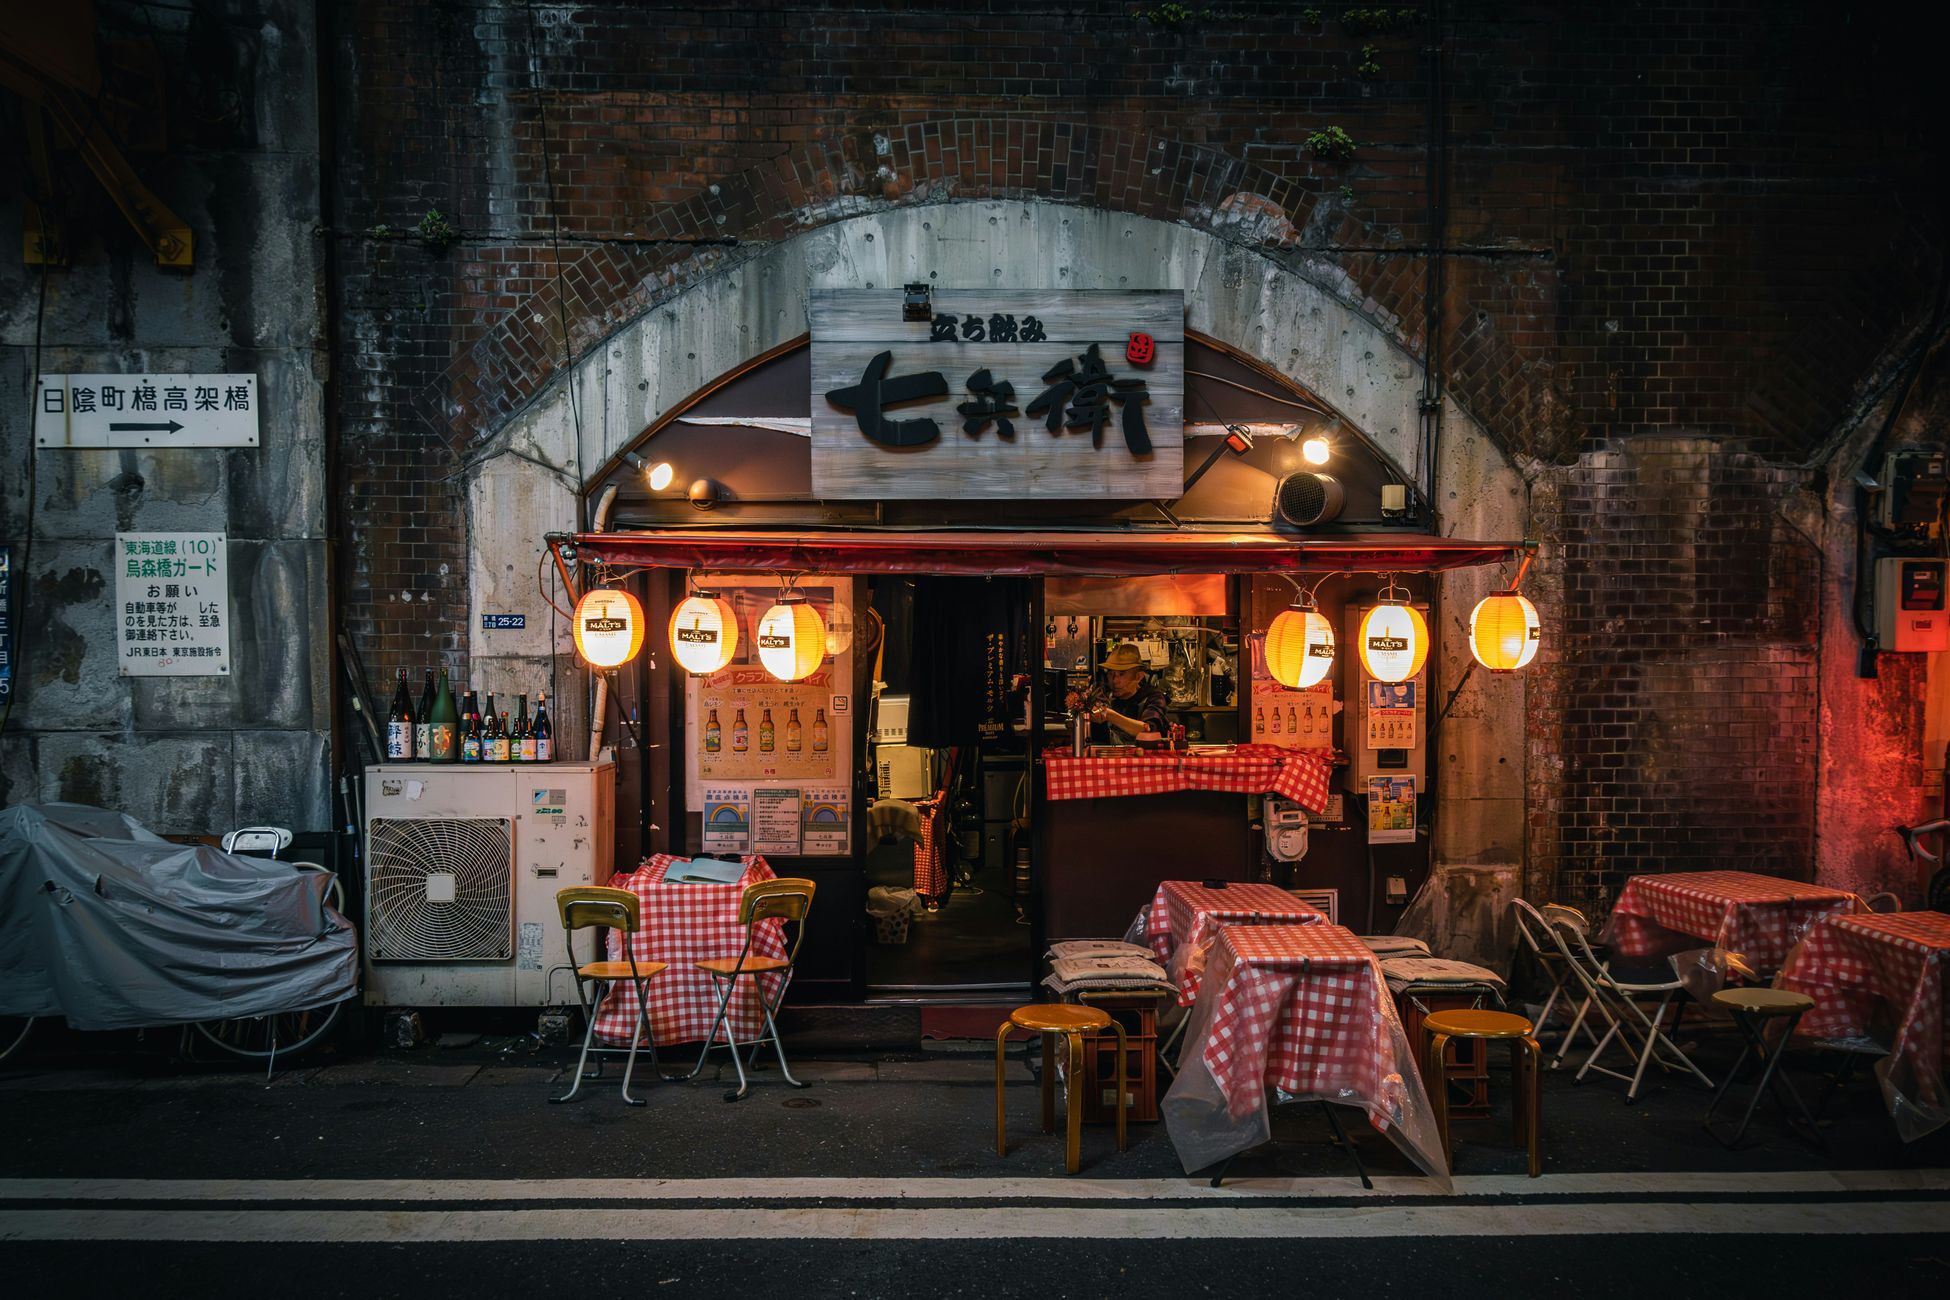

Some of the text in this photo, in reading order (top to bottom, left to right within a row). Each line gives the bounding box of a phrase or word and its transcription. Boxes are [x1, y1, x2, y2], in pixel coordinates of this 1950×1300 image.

[43, 385, 250, 414] 日陰町橋高架橋
[824, 343, 1154, 456] 七兵衛
[147, 584, 198, 598] お願い
[199, 602, 219, 614] した
[590, 621, 622, 629] MALT'S
[125, 629, 195, 642] 御連絡下さい。
[681, 633, 712, 641] MALT'S
[126, 647, 168, 657] JR東日本
